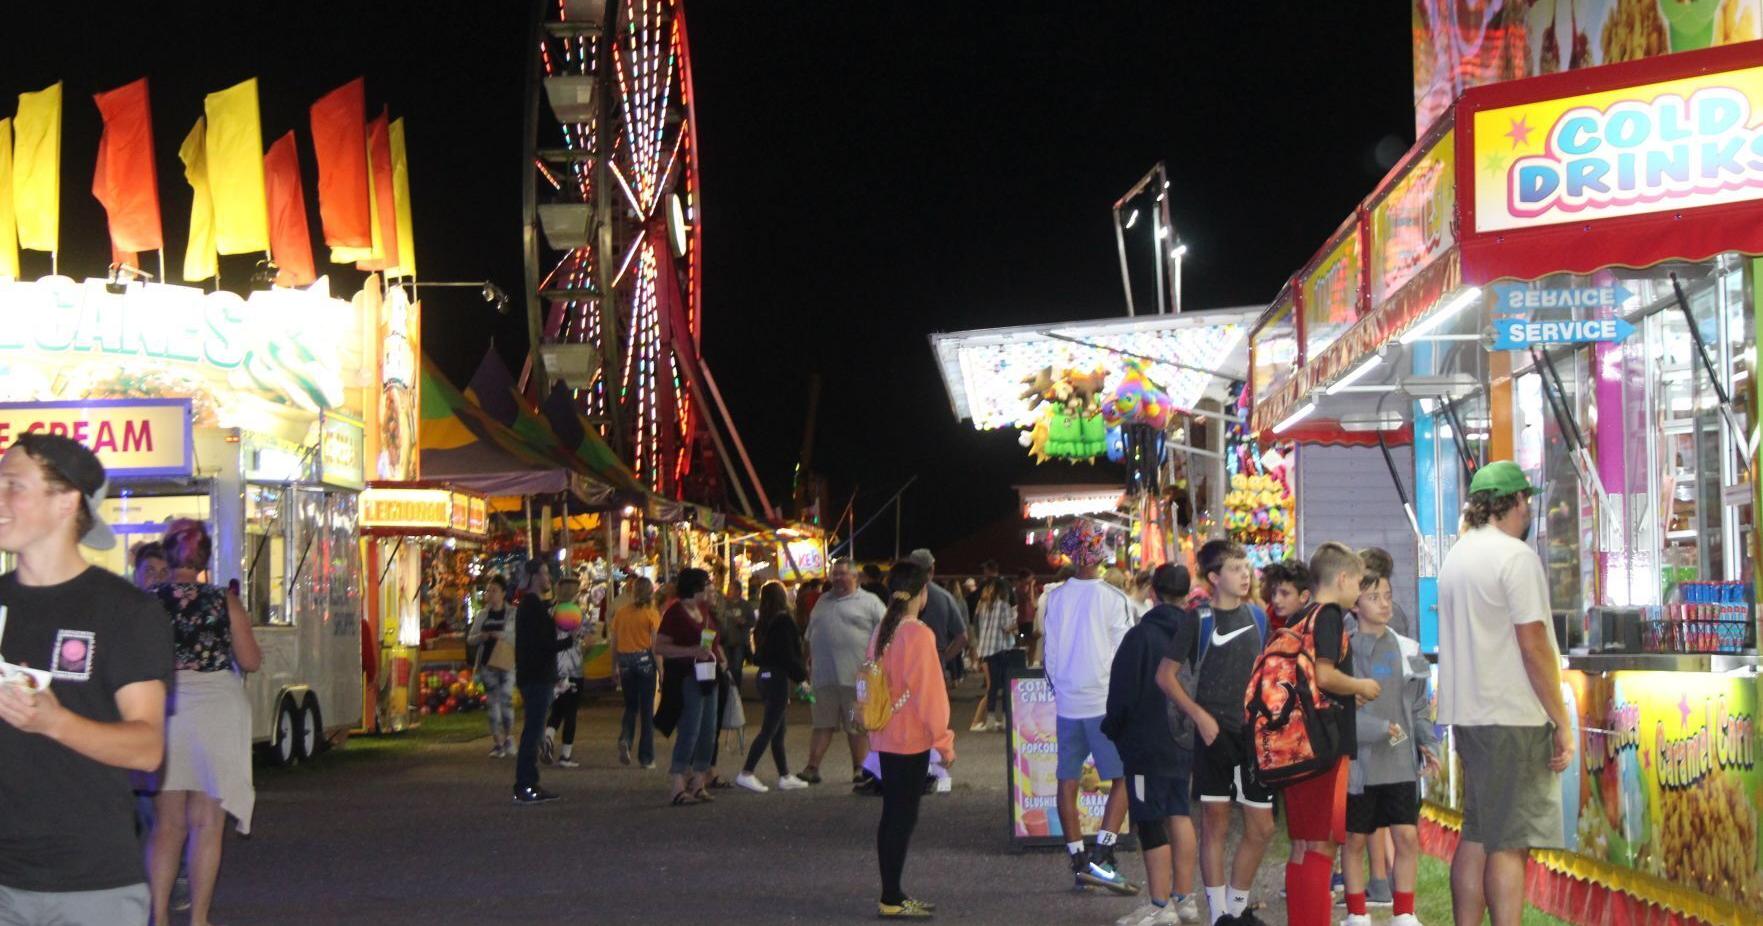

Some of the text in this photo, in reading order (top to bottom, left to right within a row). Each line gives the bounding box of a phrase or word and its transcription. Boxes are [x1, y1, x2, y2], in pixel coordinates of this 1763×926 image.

[1555, 96, 1742, 156] COLD
[1508, 320, 1618, 342] SERVICE
[1017, 680, 1049, 692] COTT
[1021, 691, 1055, 703] CAND
[1021, 742, 1058, 753] POPCOR
[1655, 693, 1755, 792] Caramel Corn
[1024, 796, 1058, 808] SLUSHIE
[1080, 794, 1109, 807] CARA
